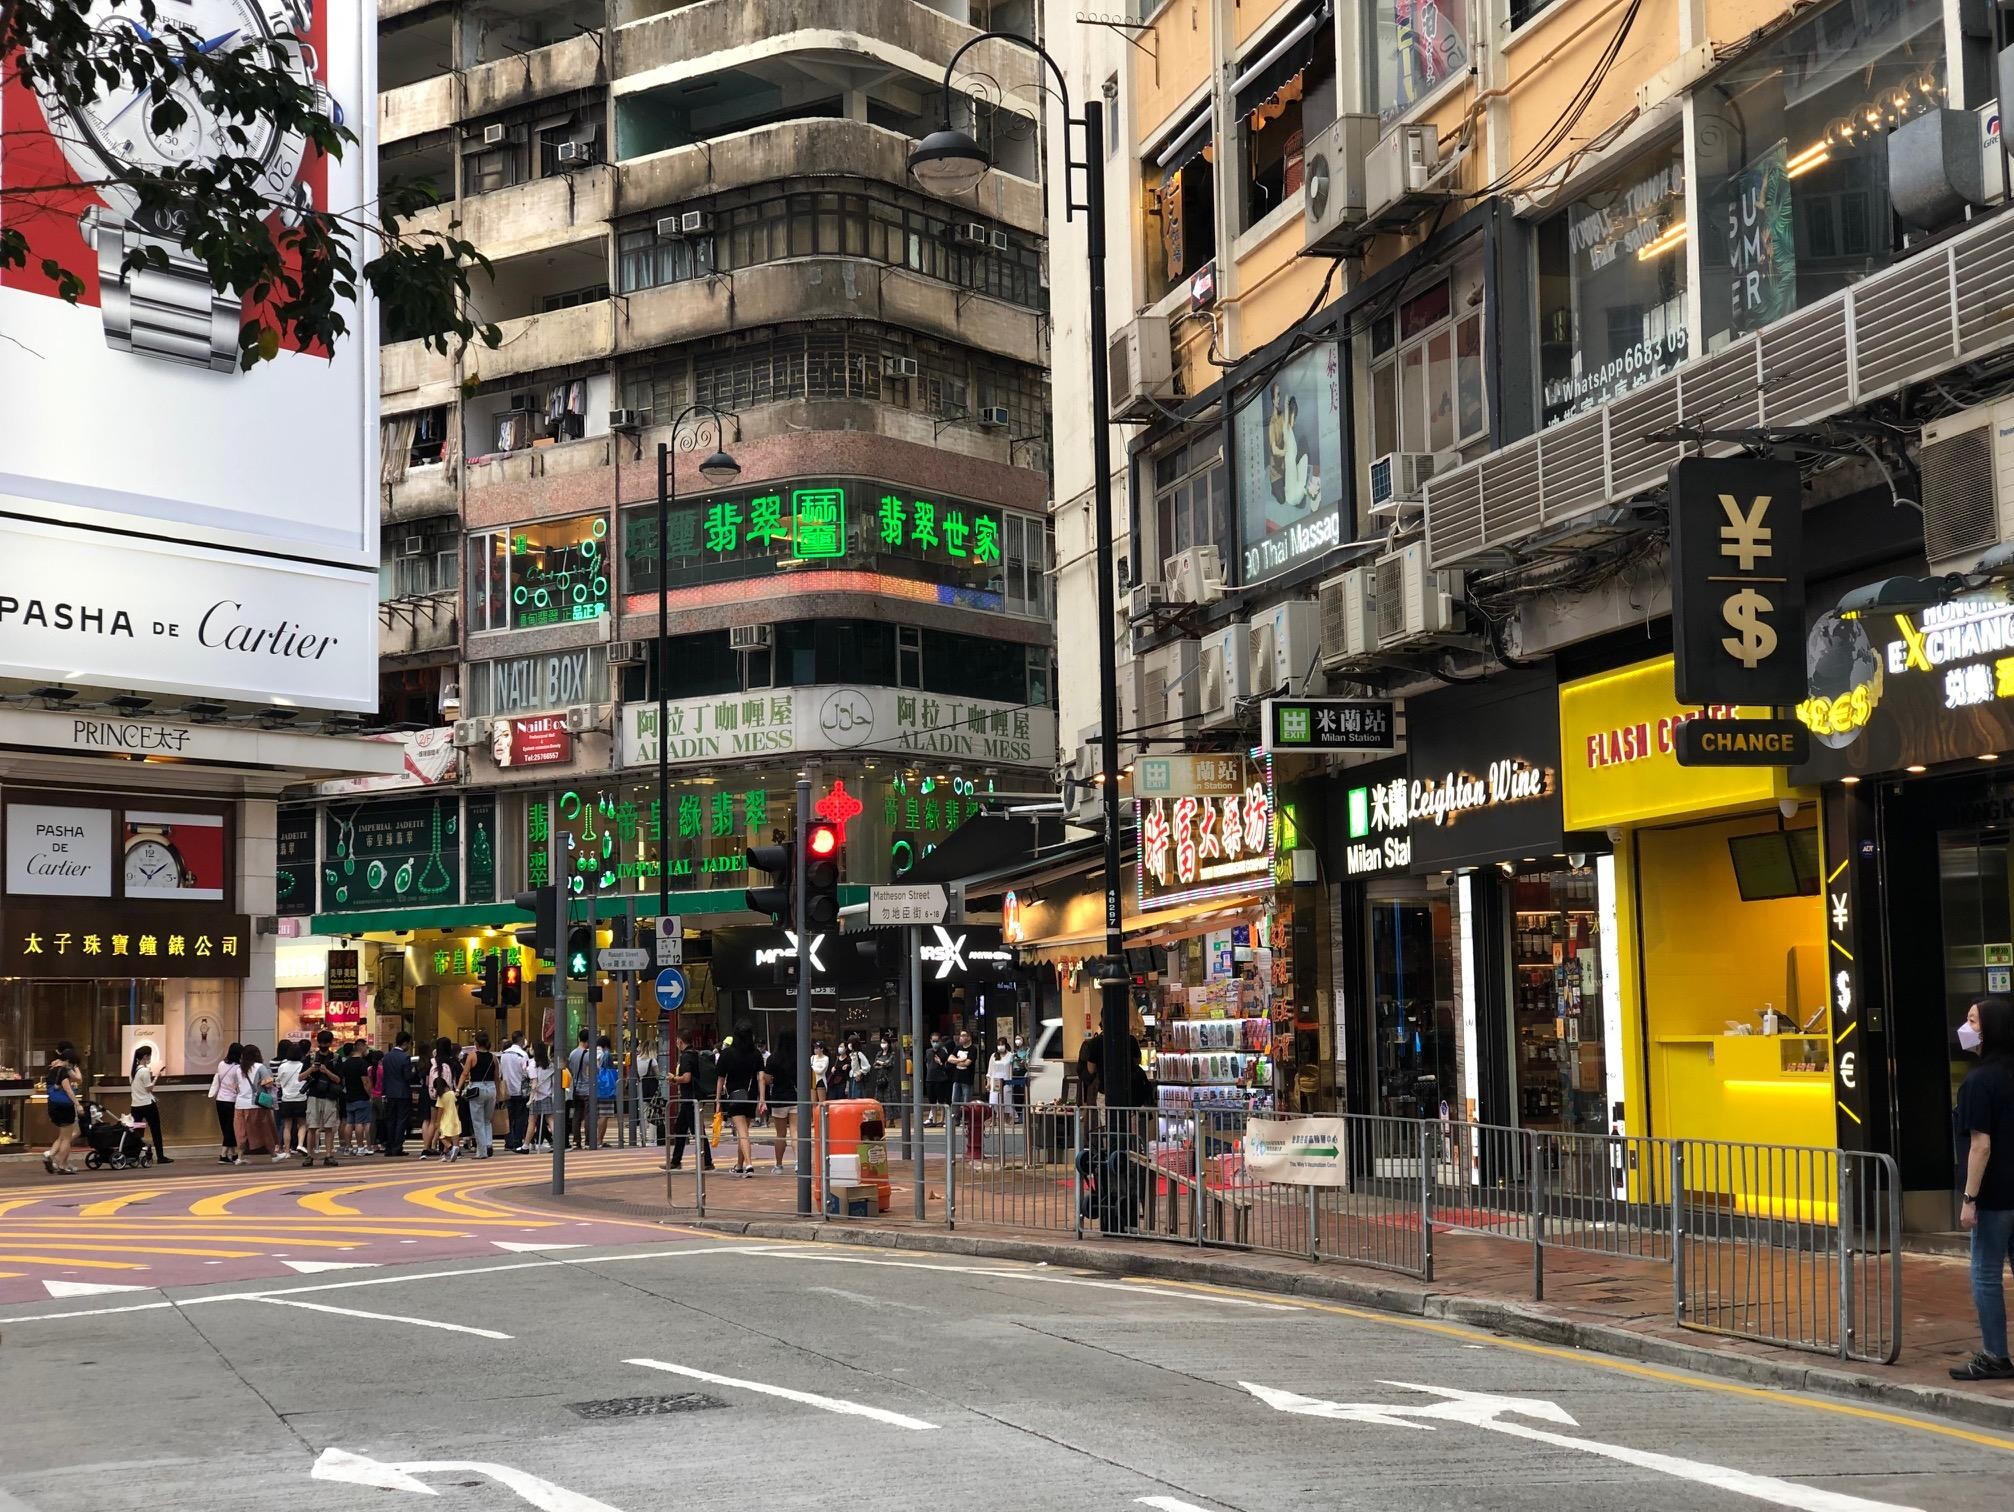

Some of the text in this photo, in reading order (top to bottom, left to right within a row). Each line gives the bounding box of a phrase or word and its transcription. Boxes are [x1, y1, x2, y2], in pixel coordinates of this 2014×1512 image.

[1984, 135, 2000, 148] GRE
[1563, 357, 1623, 402] WhatsApp
[1624, 339, 1663, 374] 6683
[879, 495, 1000, 561] 翡翠世家
[1261, 533, 1290, 570] Thai
[1291, 511, 1340, 556] Massag
[1717, 493, 1773, 570] ¥
[0, 596, 338, 660] PASHA DE Cartier
[1722, 588, 1778, 668] $
[497, 653, 584, 711] NAIL BOX
[636, 695, 793, 739] 阿拉丁咖喱屋
[897, 695, 1030, 739] 阿拉丁咖喱屋
[1315, 709, 1386, 732] 米蘭站
[74, 720, 152, 749] PRINCE
[153, 727, 190, 751] 太子
[732, 729, 793, 753] MESS
[899, 730, 1031, 761] ALADIN MESS
[1284, 731, 1306, 739] EXIT
[1321, 733, 1381, 742] Milan Station
[1587, 722, 1652, 769] FLASH
[1701, 733, 1794, 752] CHANGE
[1408, 759, 1541, 826] Leighton Wine
[36, 825, 84, 838] PASHA
[280, 831, 308, 841] JADEITE
[358, 819, 425, 833] IMPERIAL JADEITE
[52, 843, 68, 853] DE
[144, 849, 155, 858] 12
[528, 803, 549, 888] 翡翠
[26, 852, 91, 877] Cartier
[617, 858, 693, 880] IMPEIAL
[1347, 843, 1382, 875] Milan
[873, 889, 931, 901] Matheson Street
[882, 906, 922, 920] 勿地臣街
[23, 932, 239, 957] 太子珠寶鐘錶公司
[672, 955, 681, 964] 12
